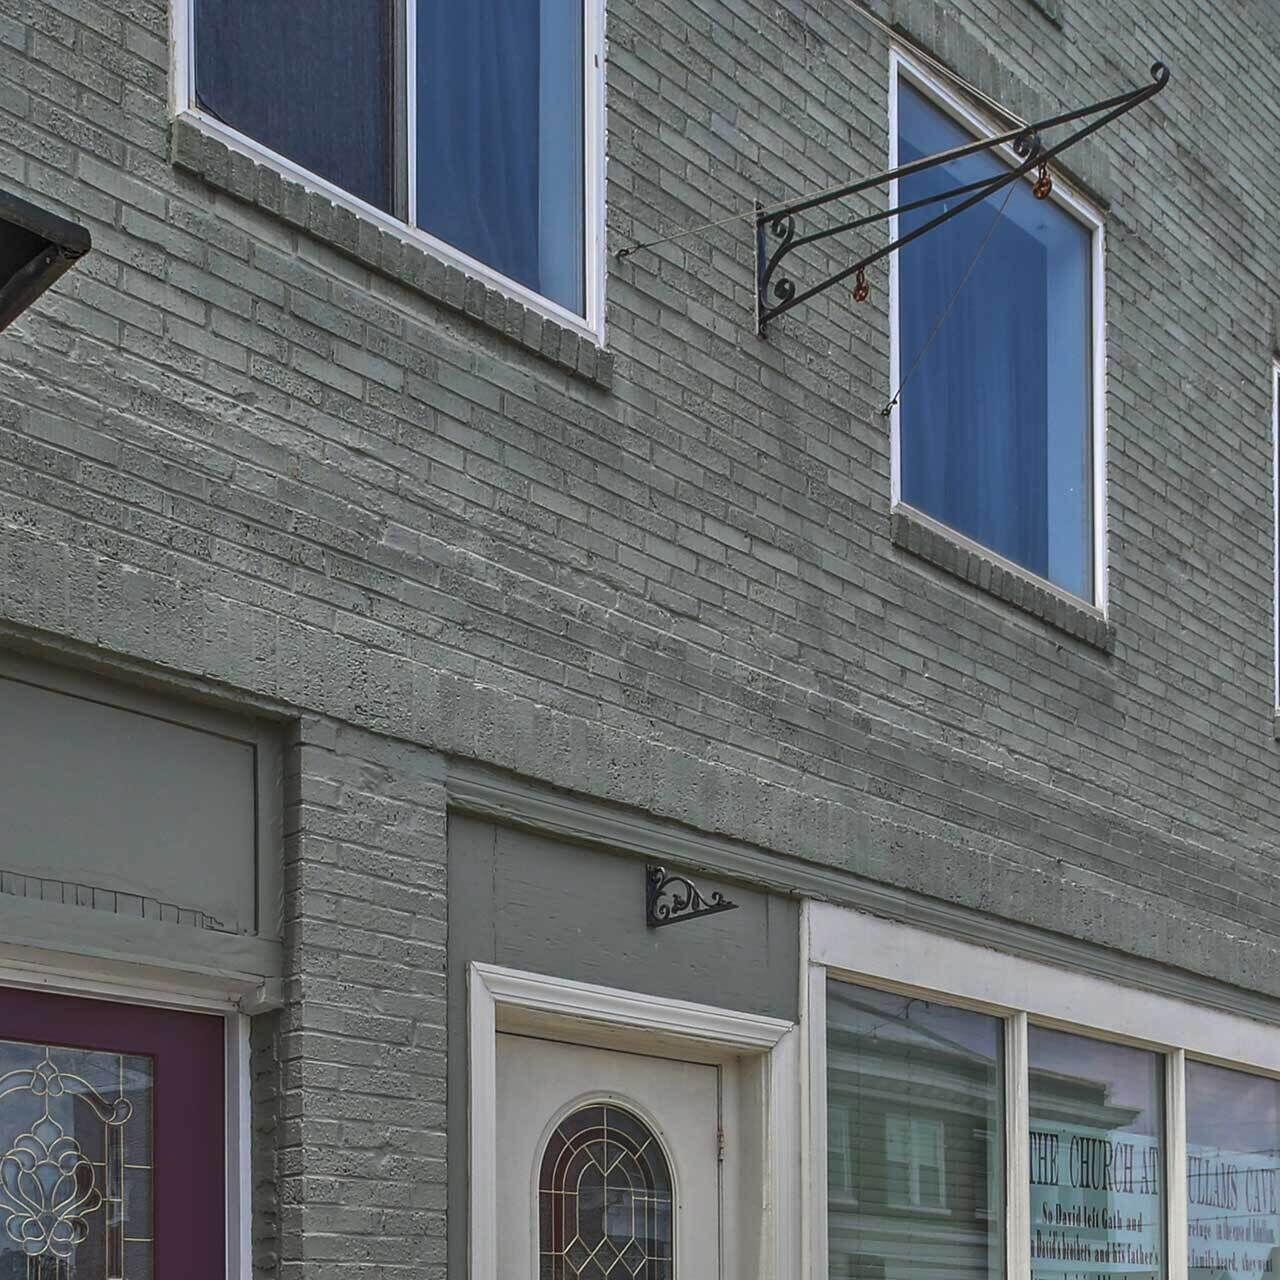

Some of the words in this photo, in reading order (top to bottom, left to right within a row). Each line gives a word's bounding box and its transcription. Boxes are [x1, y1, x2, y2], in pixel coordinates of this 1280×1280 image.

[1029, 1131, 1059, 1187] THE
[1069, 1135, 1135, 1194] CHURCH
[1140, 1146, 1160, 1196] AT
[1246, 1166, 1277, 1215] CAVE
[1042, 1200, 1053, 1225] So
[1055, 1203, 1081, 1227] David
[1083, 1205, 1099, 1229] left
[1101, 1207, 1123, 1230] Gath
[1126, 1211, 1143, 1233] and
[1036, 1229, 1061, 1260] David's
[1094, 1241, 1110, 1263] and
[1112, 1242, 1125, 1264] his
[1127, 1242, 1159, 1265] father's
